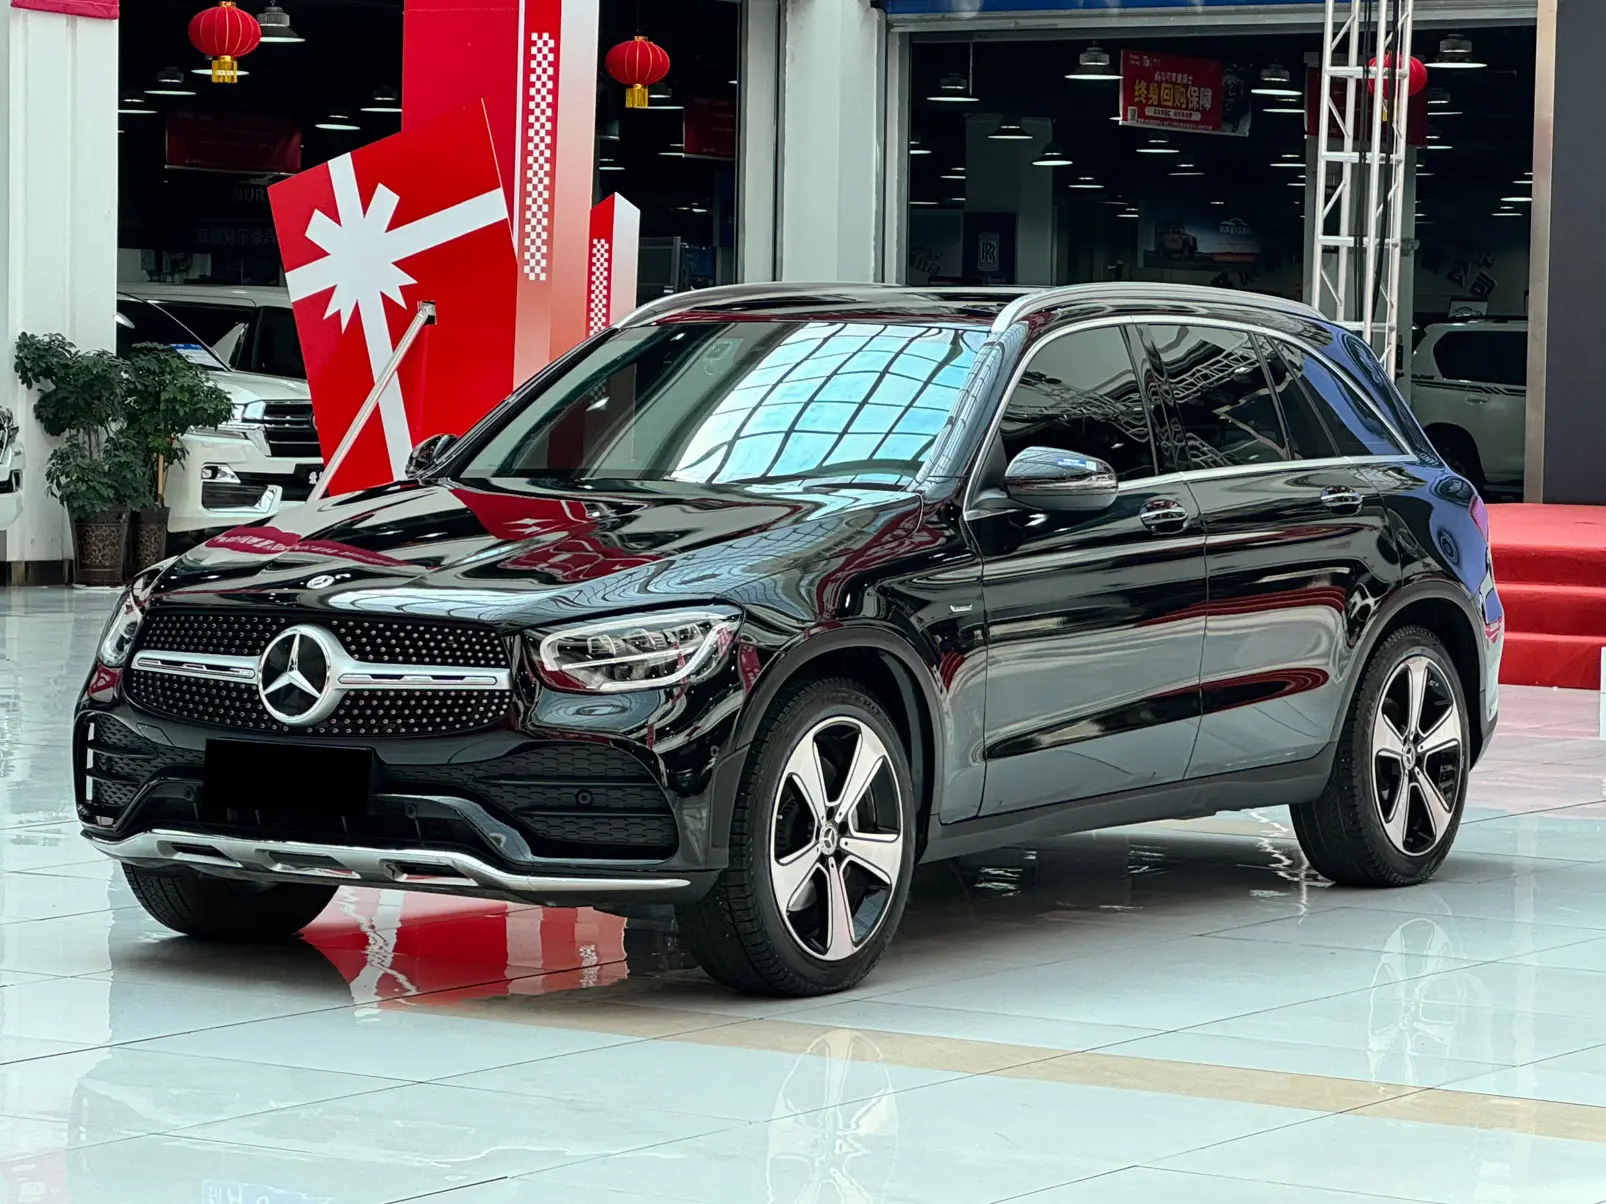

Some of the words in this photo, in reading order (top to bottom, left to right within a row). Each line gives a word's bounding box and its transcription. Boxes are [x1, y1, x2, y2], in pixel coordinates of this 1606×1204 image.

[1134, 78, 1212, 111] 终身回购保障
